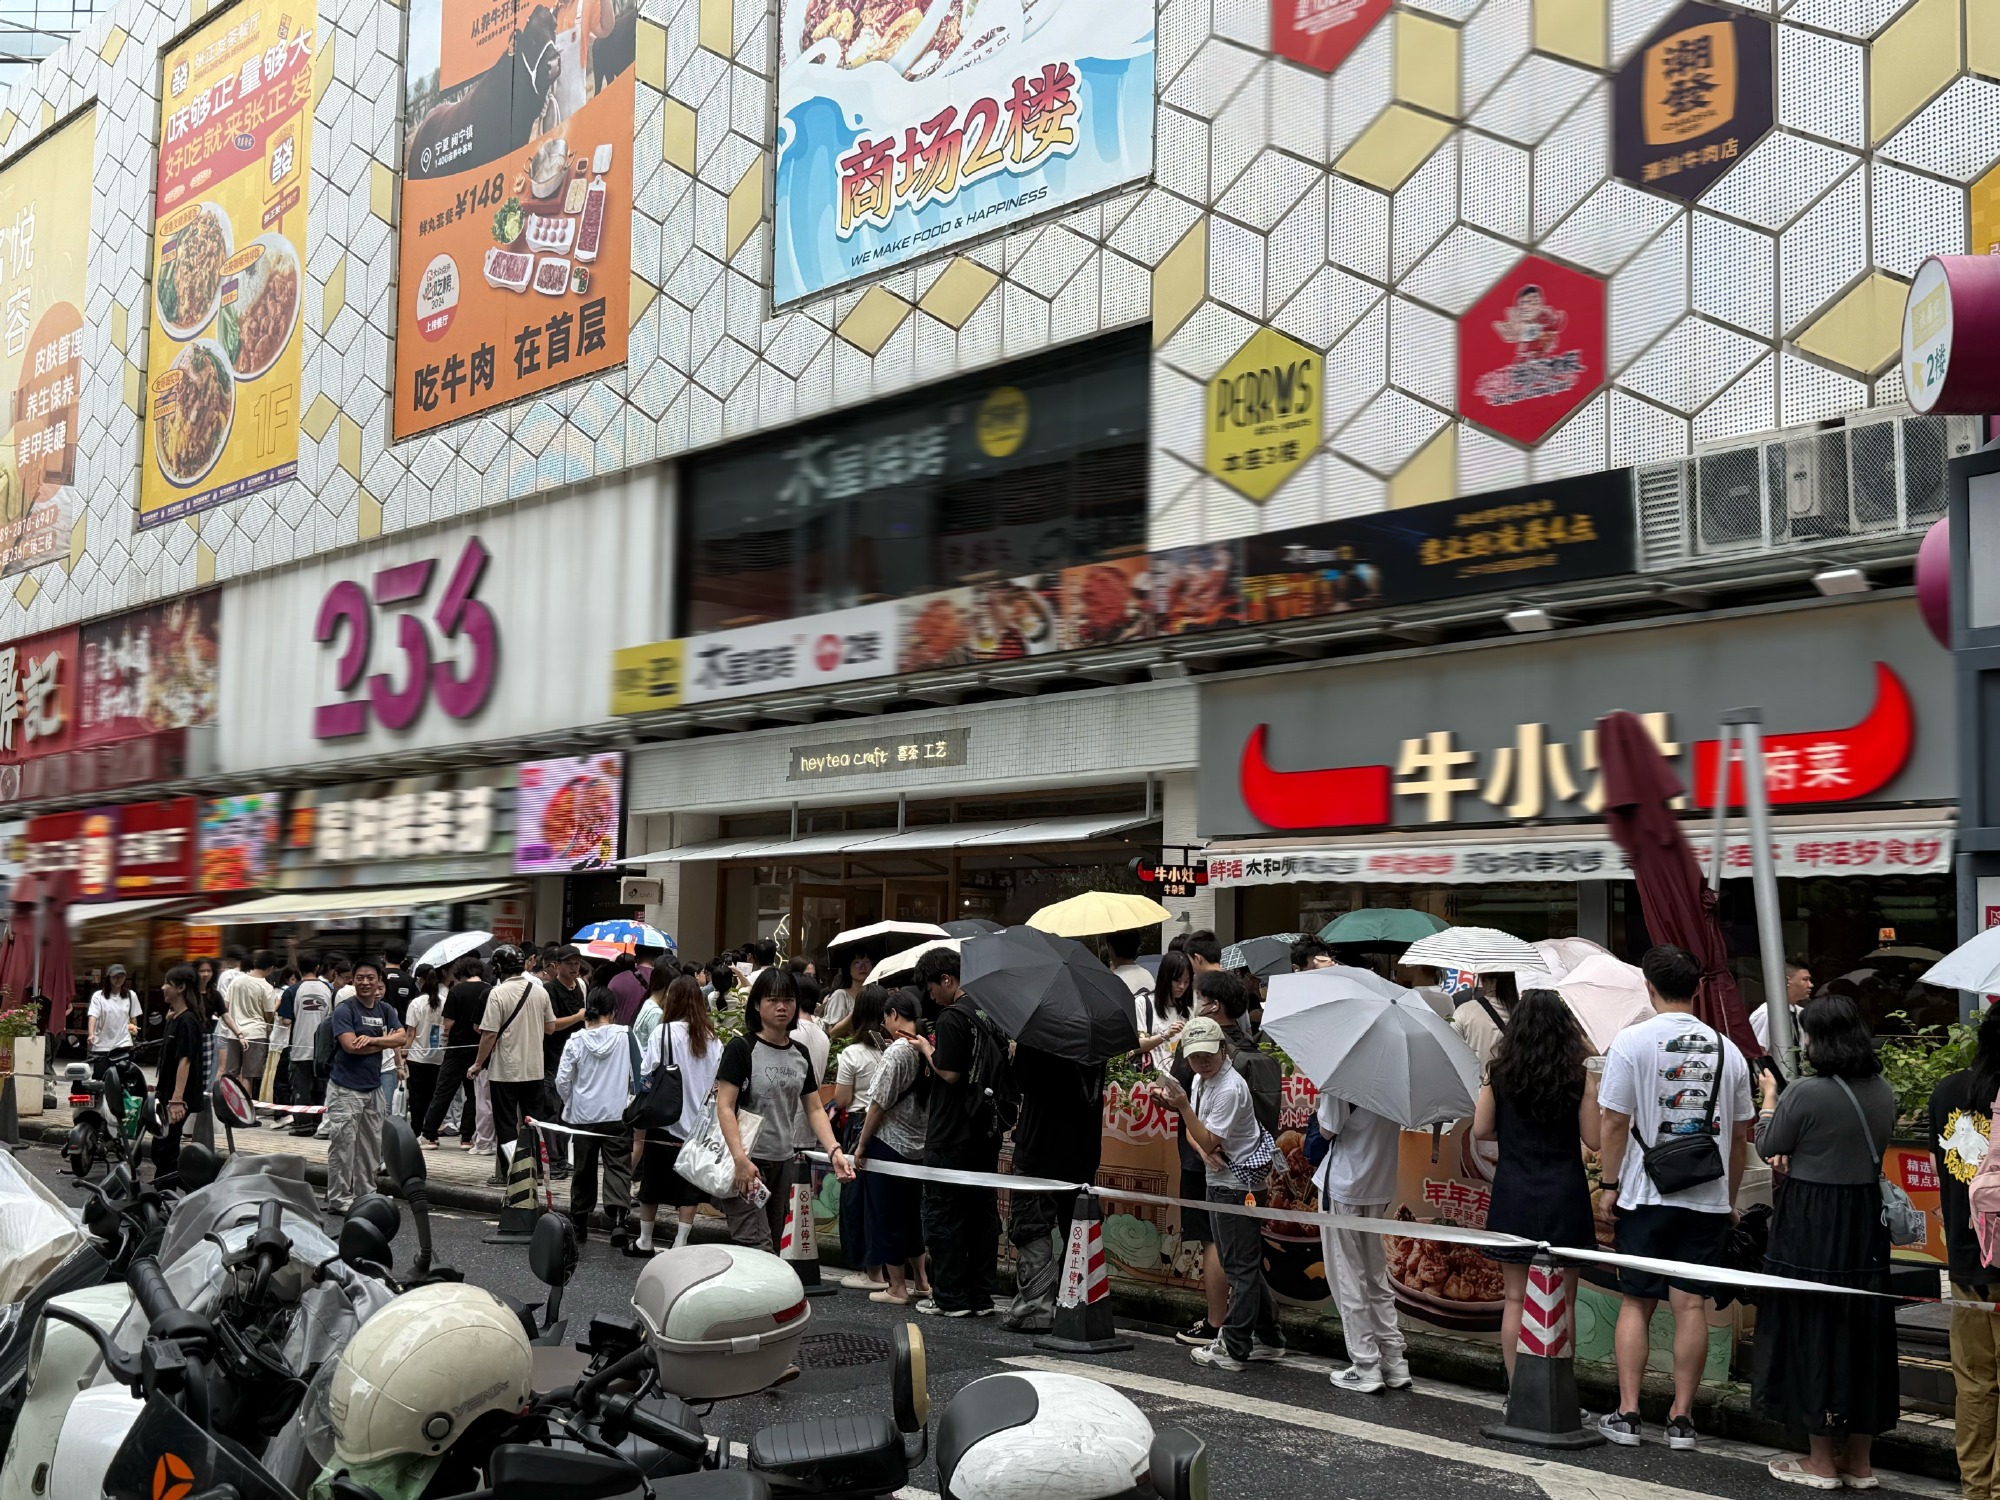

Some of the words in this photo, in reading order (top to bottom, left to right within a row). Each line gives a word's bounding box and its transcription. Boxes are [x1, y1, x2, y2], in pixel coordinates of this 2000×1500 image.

[165, 63, 311, 183] 好吃就来张正发
[839, 61, 1077, 230] 商场2楼
[455, 172, 504, 220] ¥148
[851, 251, 870, 267] WE
[873, 236, 911, 258] MAKE
[913, 222, 951, 245] FOOD
[954, 217, 963, 229] &
[966, 186, 1049, 226] HAPPINESS
[4, 284, 32, 358] 容
[514, 297, 606, 379] 在首层
[34, 327, 84, 378] 皮肤管理
[414, 342, 495, 412] 吃牛肉
[1927, 343, 1946, 387] 2楼
[26, 375, 75, 424] 养生保养
[253, 384, 292, 459] 1F
[312, 535, 499, 739] 236
[801, 755, 850, 772] heytea
[853, 747, 888, 767] craft
[923, 741, 947, 758] 工艺
[1154, 866, 1195, 884] 牛小灶
[1210, 860, 1243, 881] 鲜活
[1907, 1159, 1931, 1173] 精选
[801, 1204, 811, 1253] 禁止停车
[1068, 1242, 1081, 1298] 禁止停车
